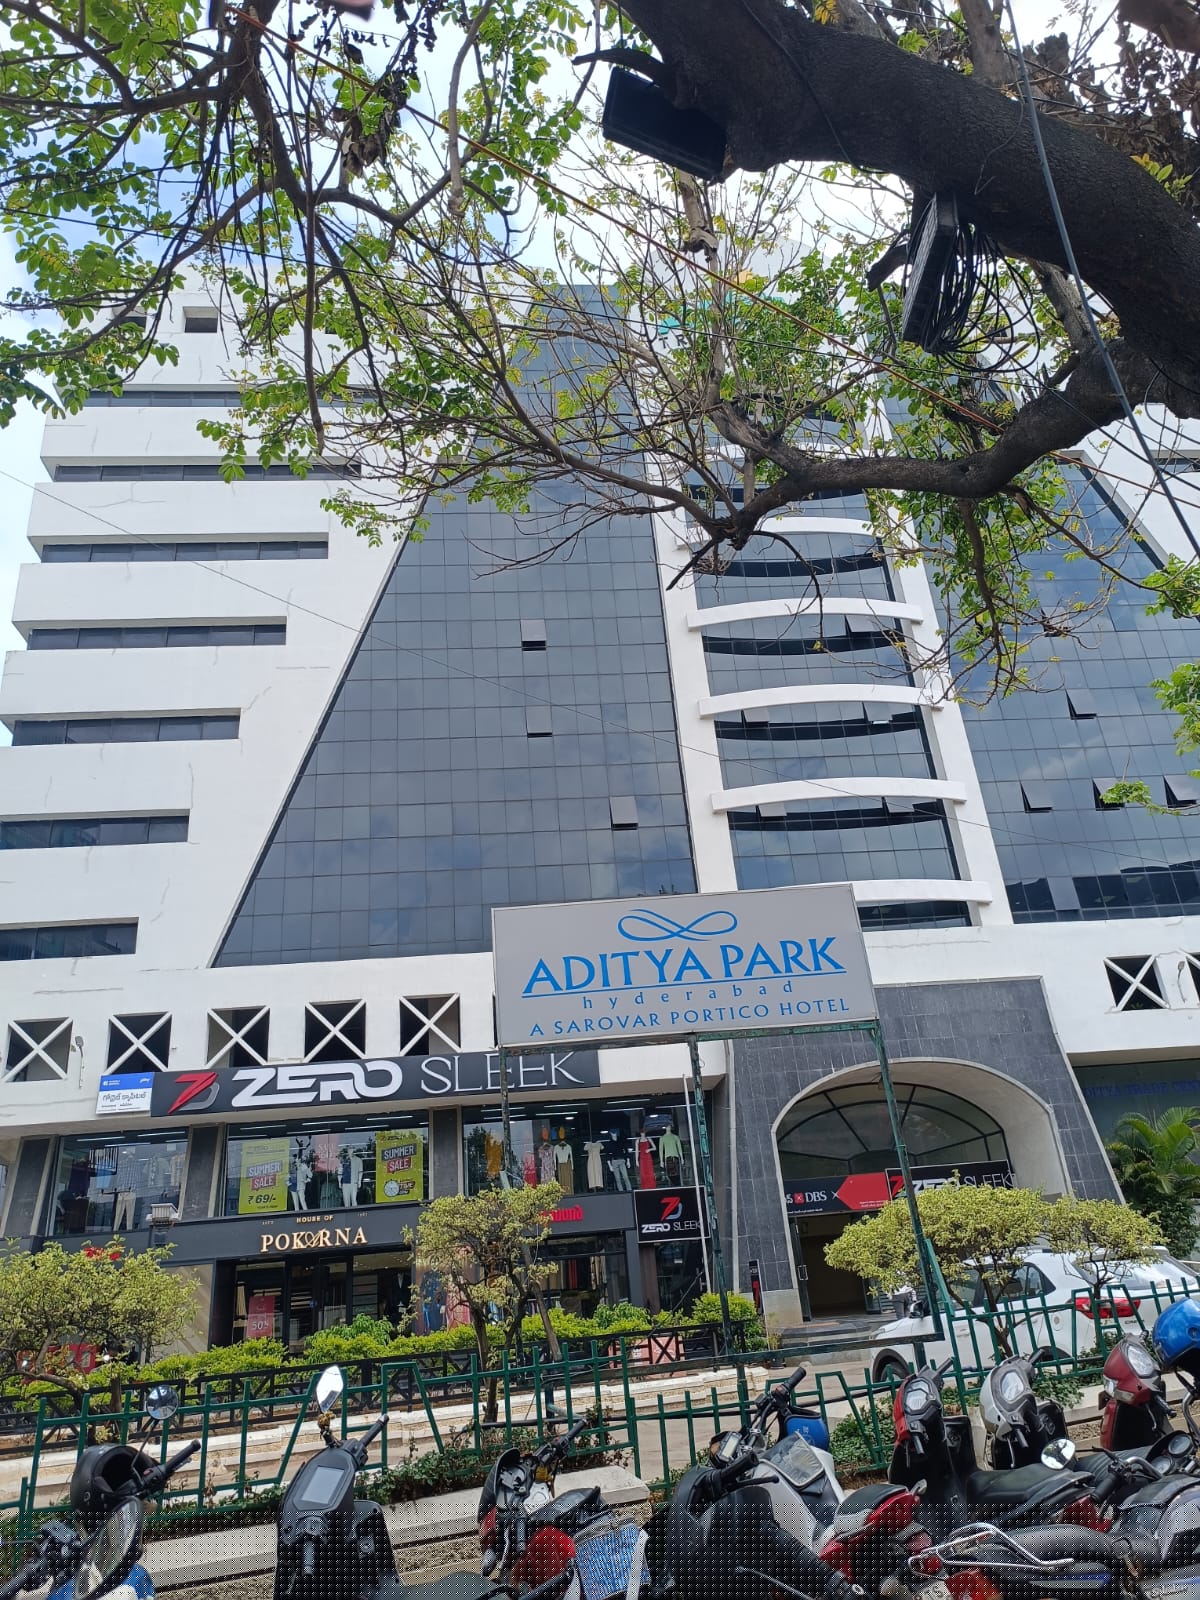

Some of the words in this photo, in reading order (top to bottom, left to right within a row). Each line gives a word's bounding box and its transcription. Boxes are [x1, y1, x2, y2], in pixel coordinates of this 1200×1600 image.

[522, 946, 713, 994] ADITYA
[720, 936, 845, 978] PARK
[583, 980, 793, 1009] hyderabad
[530, 1023, 545, 1037] A
[554, 1012, 661, 1035] SAROVAR
[671, 1004, 769, 1025] PORTICO
[780, 998, 849, 1016] HOTEL
[231, 1060, 403, 1107] ZERO
[421, 1051, 585, 1094] SLEEK
[383, 1144, 415, 1161] SUMMER
[248, 1161, 281, 1177] SUMMER
[389, 1160, 410, 1172] SALE
[253, 1175, 275, 1189] SALE
[805, 1190, 828, 1203] DBS
[296, 1215, 321, 1224] HOUSE
[323, 1214, 335, 1222] OF
[641, 1222, 671, 1233] ZERO
